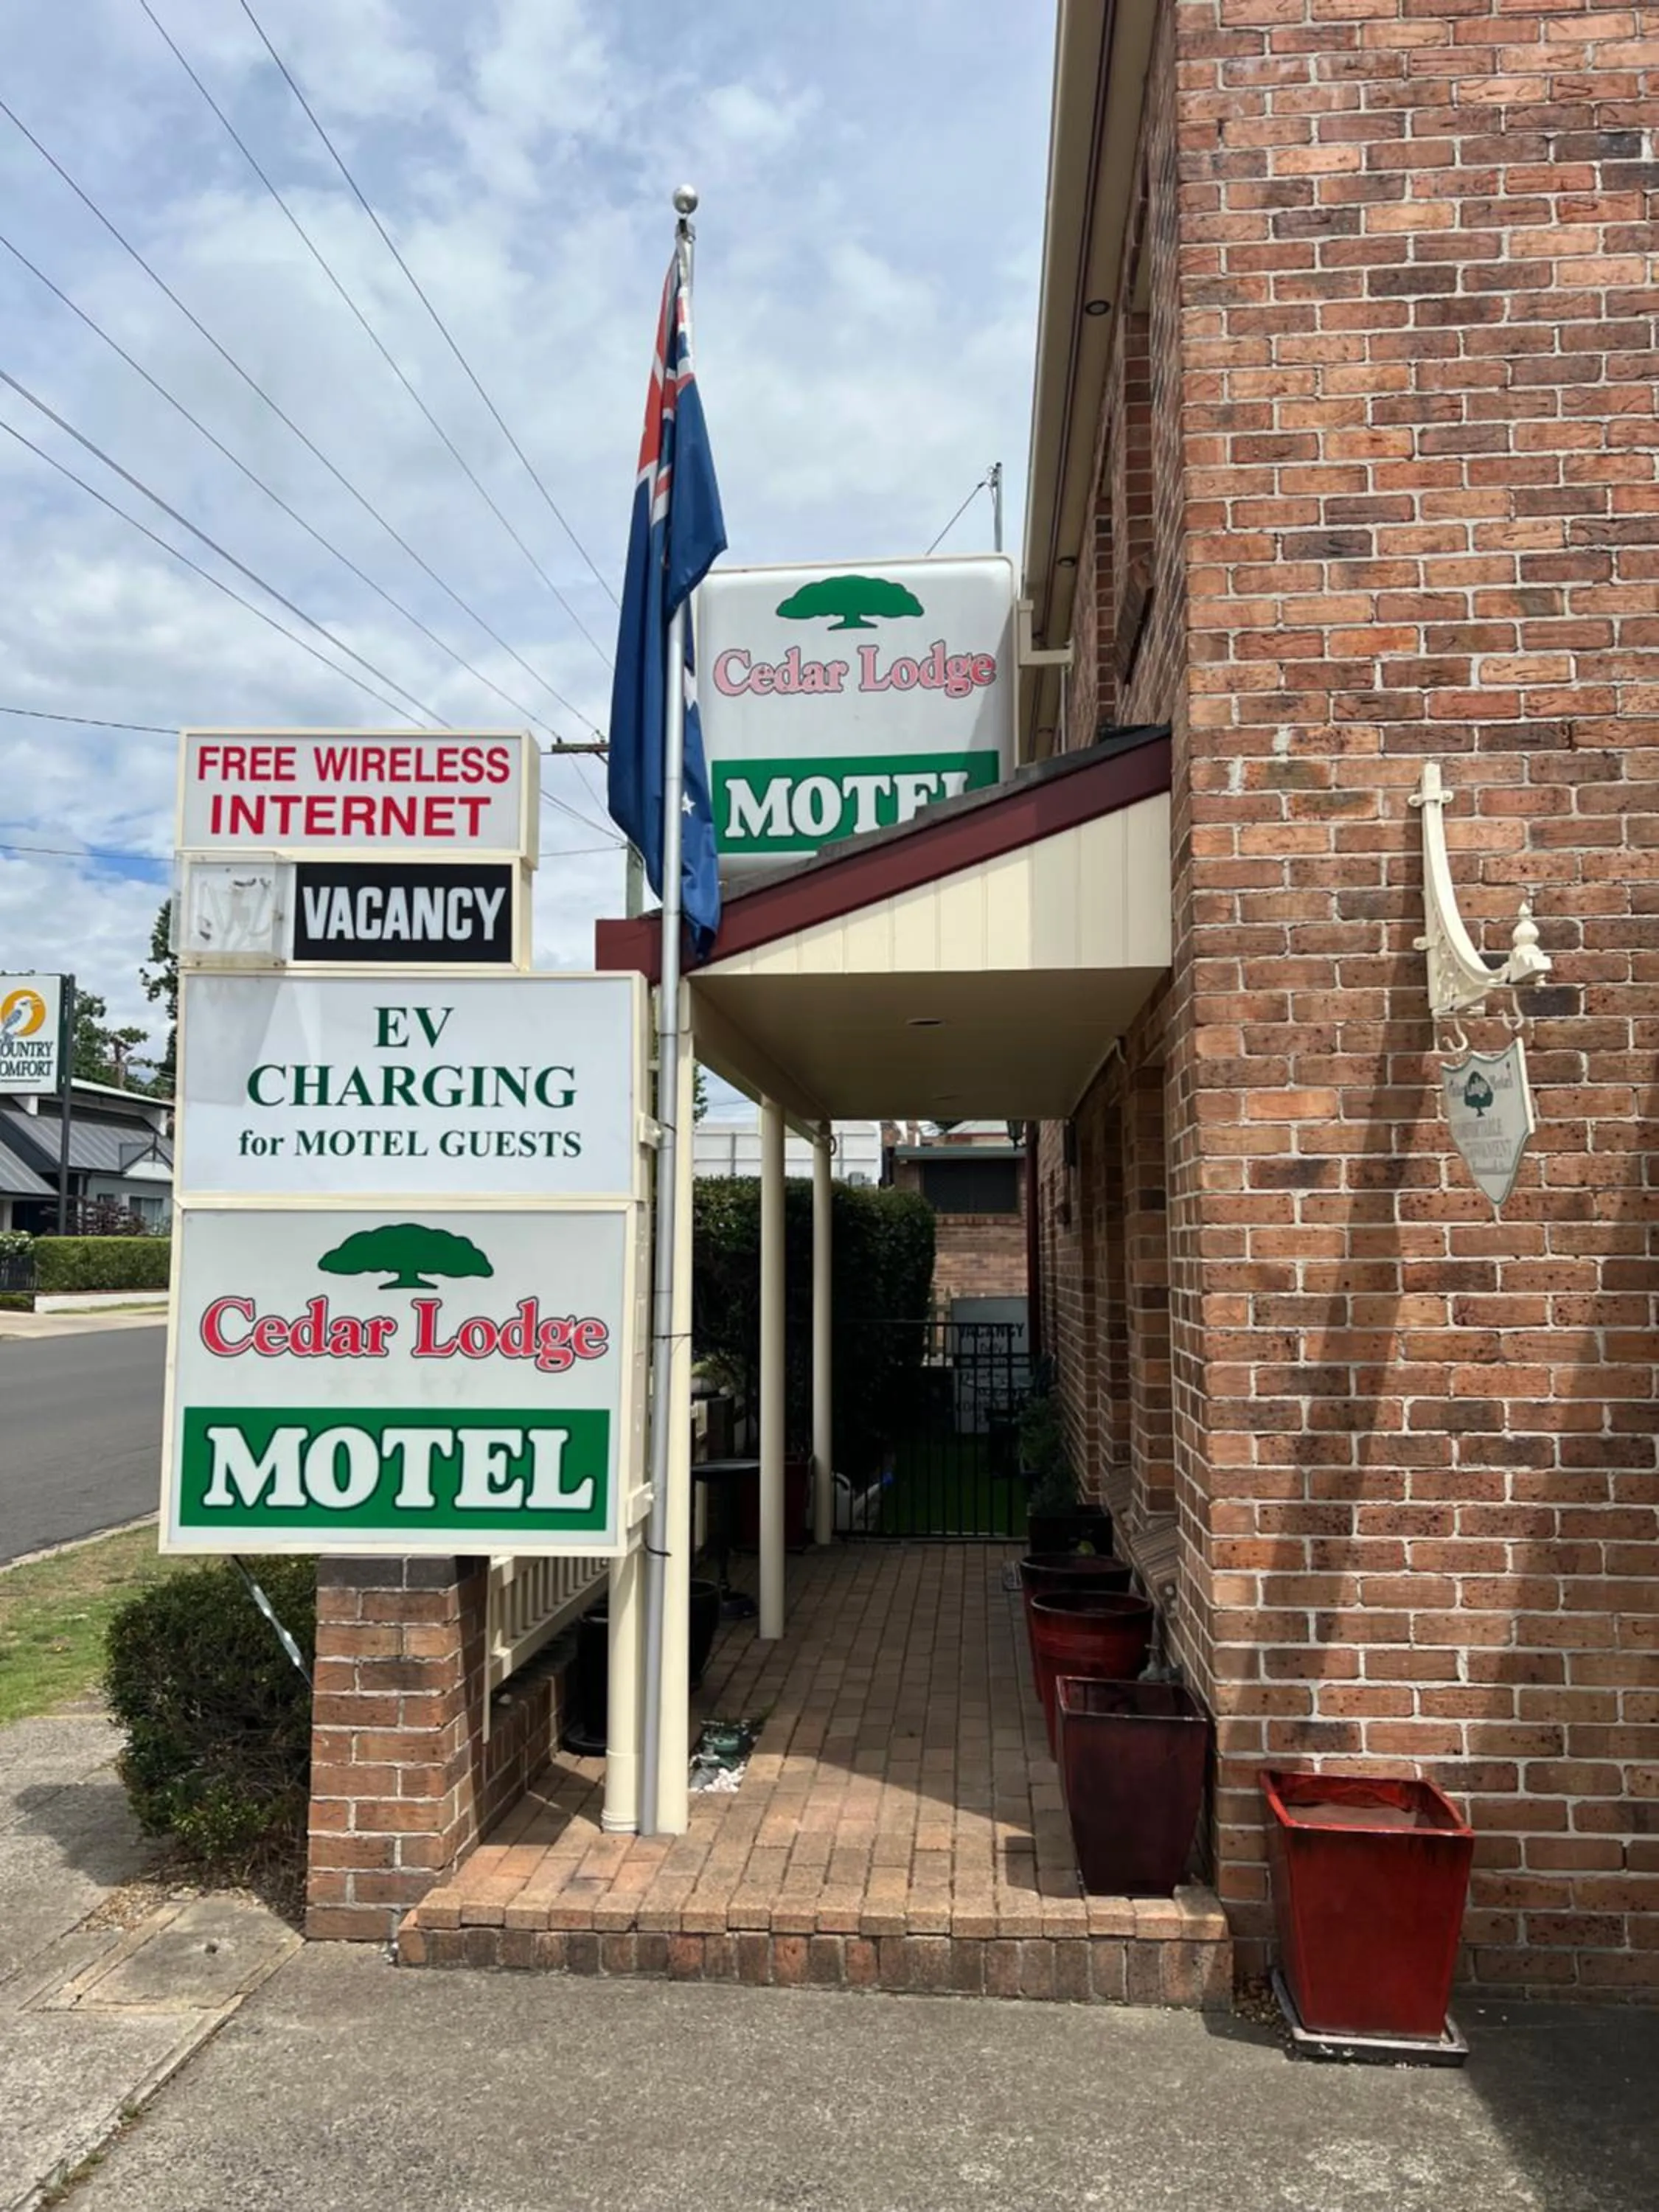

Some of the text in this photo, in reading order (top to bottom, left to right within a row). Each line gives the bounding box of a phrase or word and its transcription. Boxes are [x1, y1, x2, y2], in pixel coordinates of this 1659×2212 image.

[714, 639, 995, 698] Cedar Lodge
[198, 746, 510, 784] FREE WIRELESS
[211, 794, 491, 837] INTERNET
[303, 886, 505, 941] VACANCY
[373, 1006, 454, 1048] EV
[0, 1041, 53, 1057] OUNTRY
[0, 1060, 53, 1076] OMFORT
[247, 1064, 577, 1107] CHARGING
[238, 1130, 582, 1158] for MOTEL GUESTS
[201, 1294, 609, 1372] Cedar Lodge
[203, 1426, 594, 1509] MOTEL
